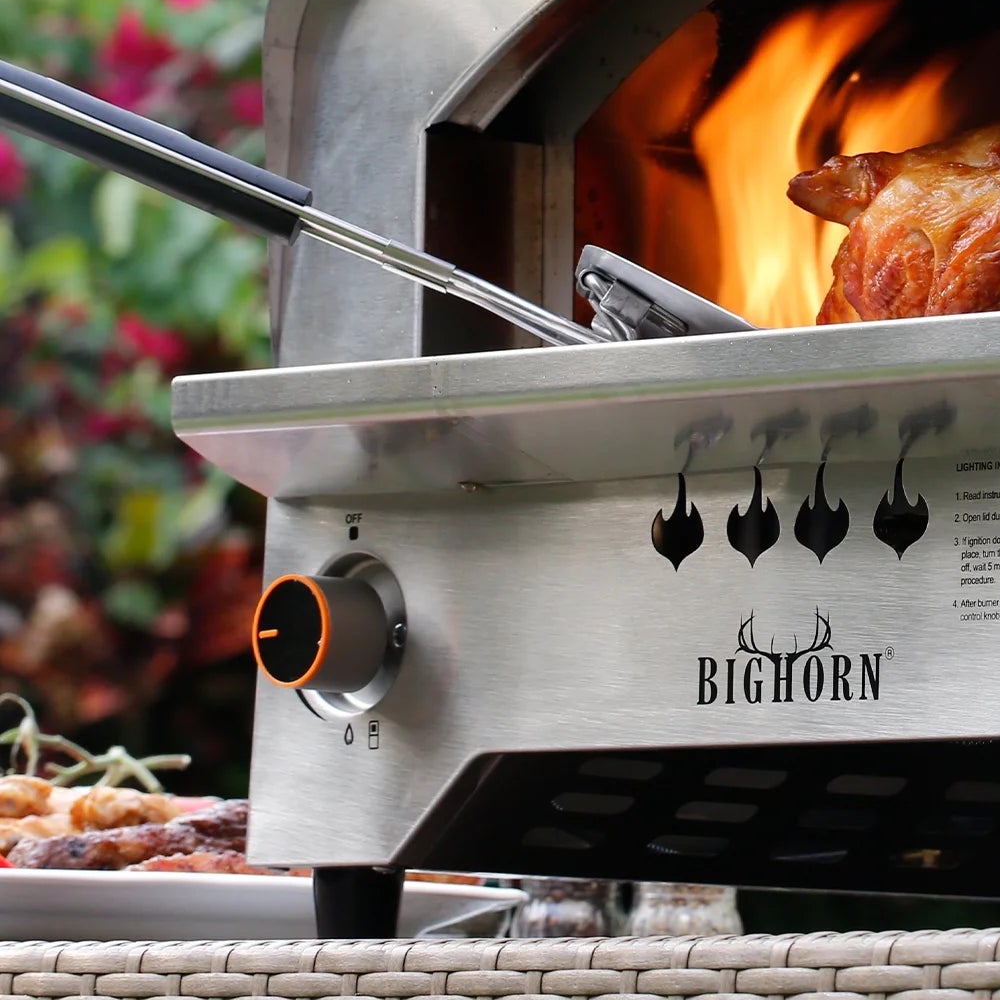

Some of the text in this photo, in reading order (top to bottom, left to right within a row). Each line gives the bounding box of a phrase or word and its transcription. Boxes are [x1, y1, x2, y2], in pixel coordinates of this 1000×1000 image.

[956, 461, 993, 472] LIGHTING
[963, 491, 981, 501] Read
[345, 513, 363, 525] OFF
[962, 513, 980, 523] Open
[982, 511, 990, 521] lid
[961, 536, 967, 545] If
[968, 536, 991, 548] ignition
[982, 549, 996, 559] turn
[960, 562, 972, 573] off,
[972, 562, 987, 572] wait
[987, 561, 993, 572] 5
[960, 599, 977, 608] After
[977, 598, 1000, 608] burner
[960, 612, 983, 622] control
[983, 611, 1000, 621] knob
